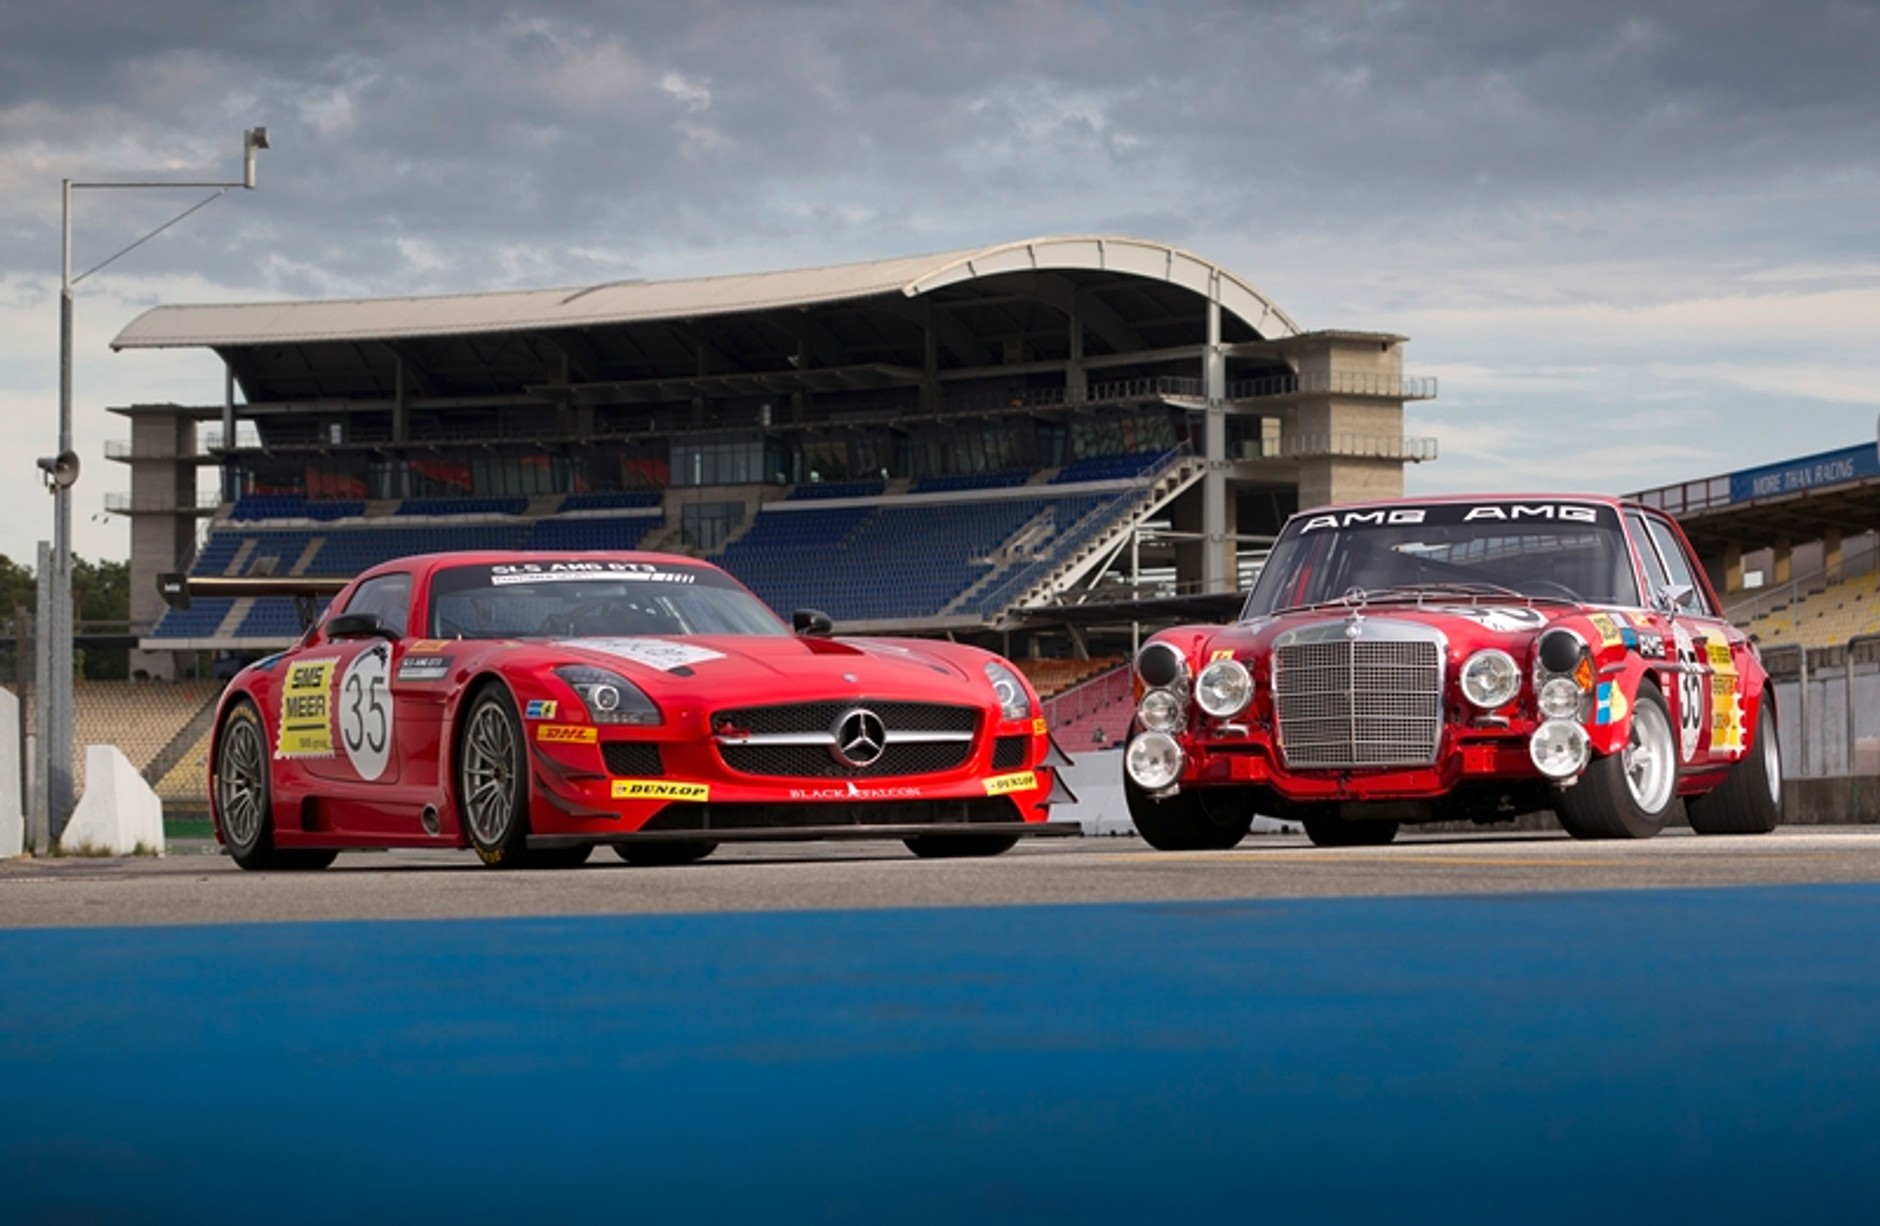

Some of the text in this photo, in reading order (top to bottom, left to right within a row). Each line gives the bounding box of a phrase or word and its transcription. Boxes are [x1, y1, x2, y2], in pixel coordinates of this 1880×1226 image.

[1753, 458, 1855, 496] MORE THAN RACING
[1300, 505, 1597, 534] AMG AMG
[491, 563, 541, 574] SLS
[551, 563, 602, 571] AMG
[292, 667, 325, 688] SMS
[286, 695, 326, 719] MEER
[344, 673, 387, 754] 35
[545, 728, 587, 740] DHL
[629, 784, 706, 796] DUNLOP
[996, 775, 1034, 788] DUNLOP
[789, 788, 845, 799] BLACK
